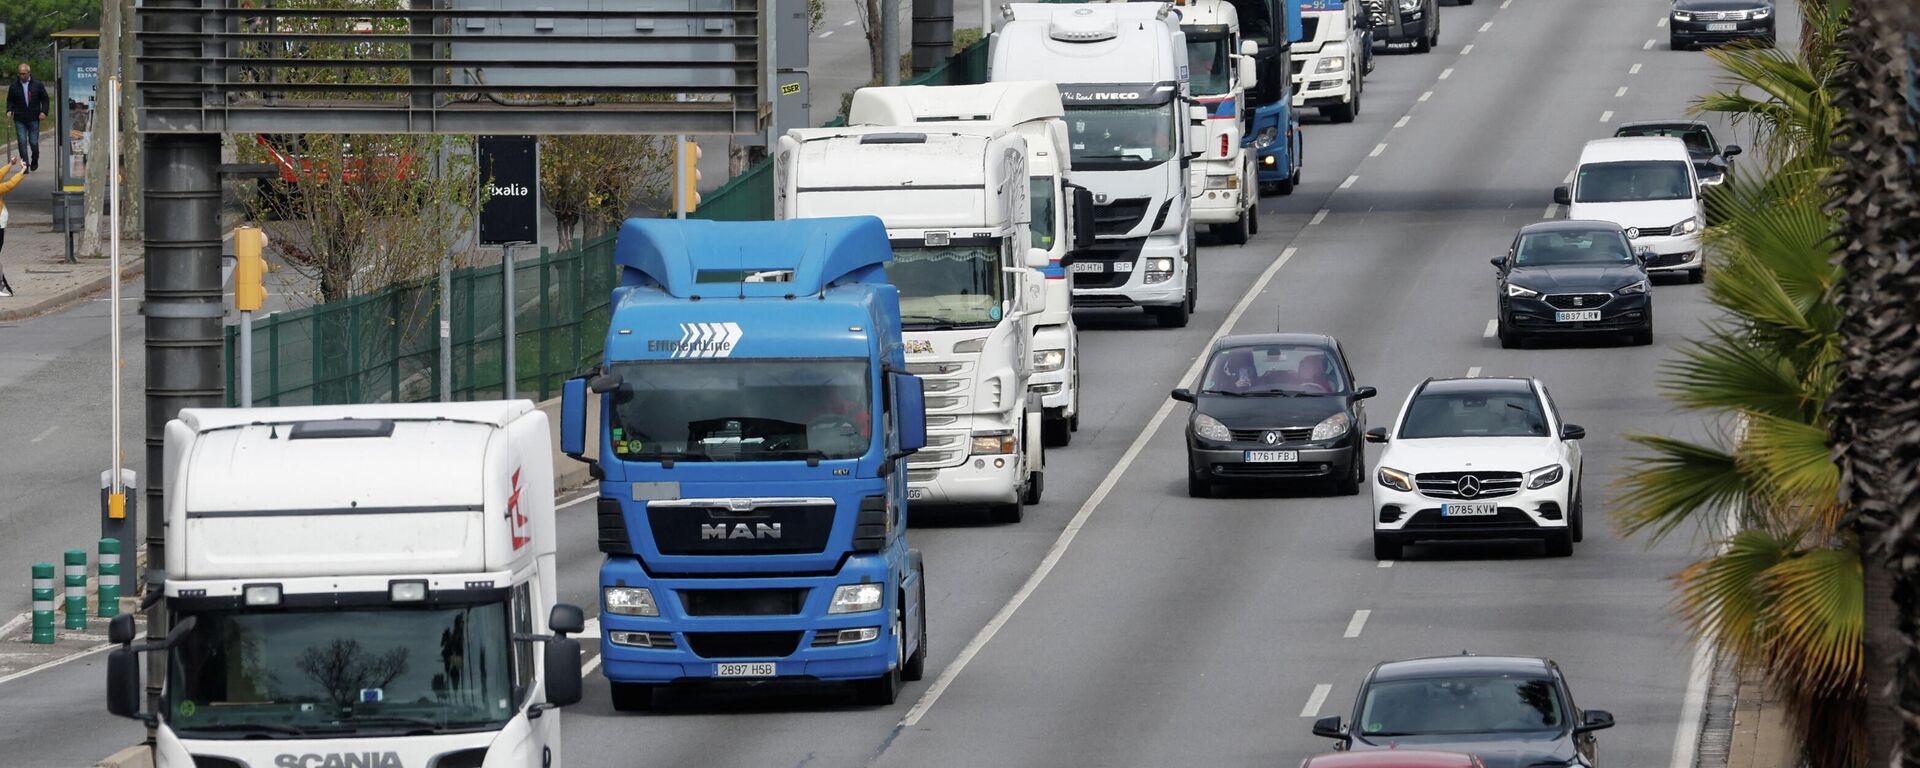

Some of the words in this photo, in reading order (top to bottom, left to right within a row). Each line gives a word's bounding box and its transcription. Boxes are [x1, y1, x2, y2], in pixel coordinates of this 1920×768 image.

[1087, 263, 1102, 271] HTH
[1253, 452, 1274, 460] 1761
[1277, 452, 1295, 460] FBJ
[1448, 505, 1474, 514] 0785
[1476, 504, 1495, 513] KVW
[701, 523, 781, 539] MAN
[721, 664, 748, 675] 2897
[751, 664, 772, 675] HSB
[274, 751, 404, 768] SCANIA
